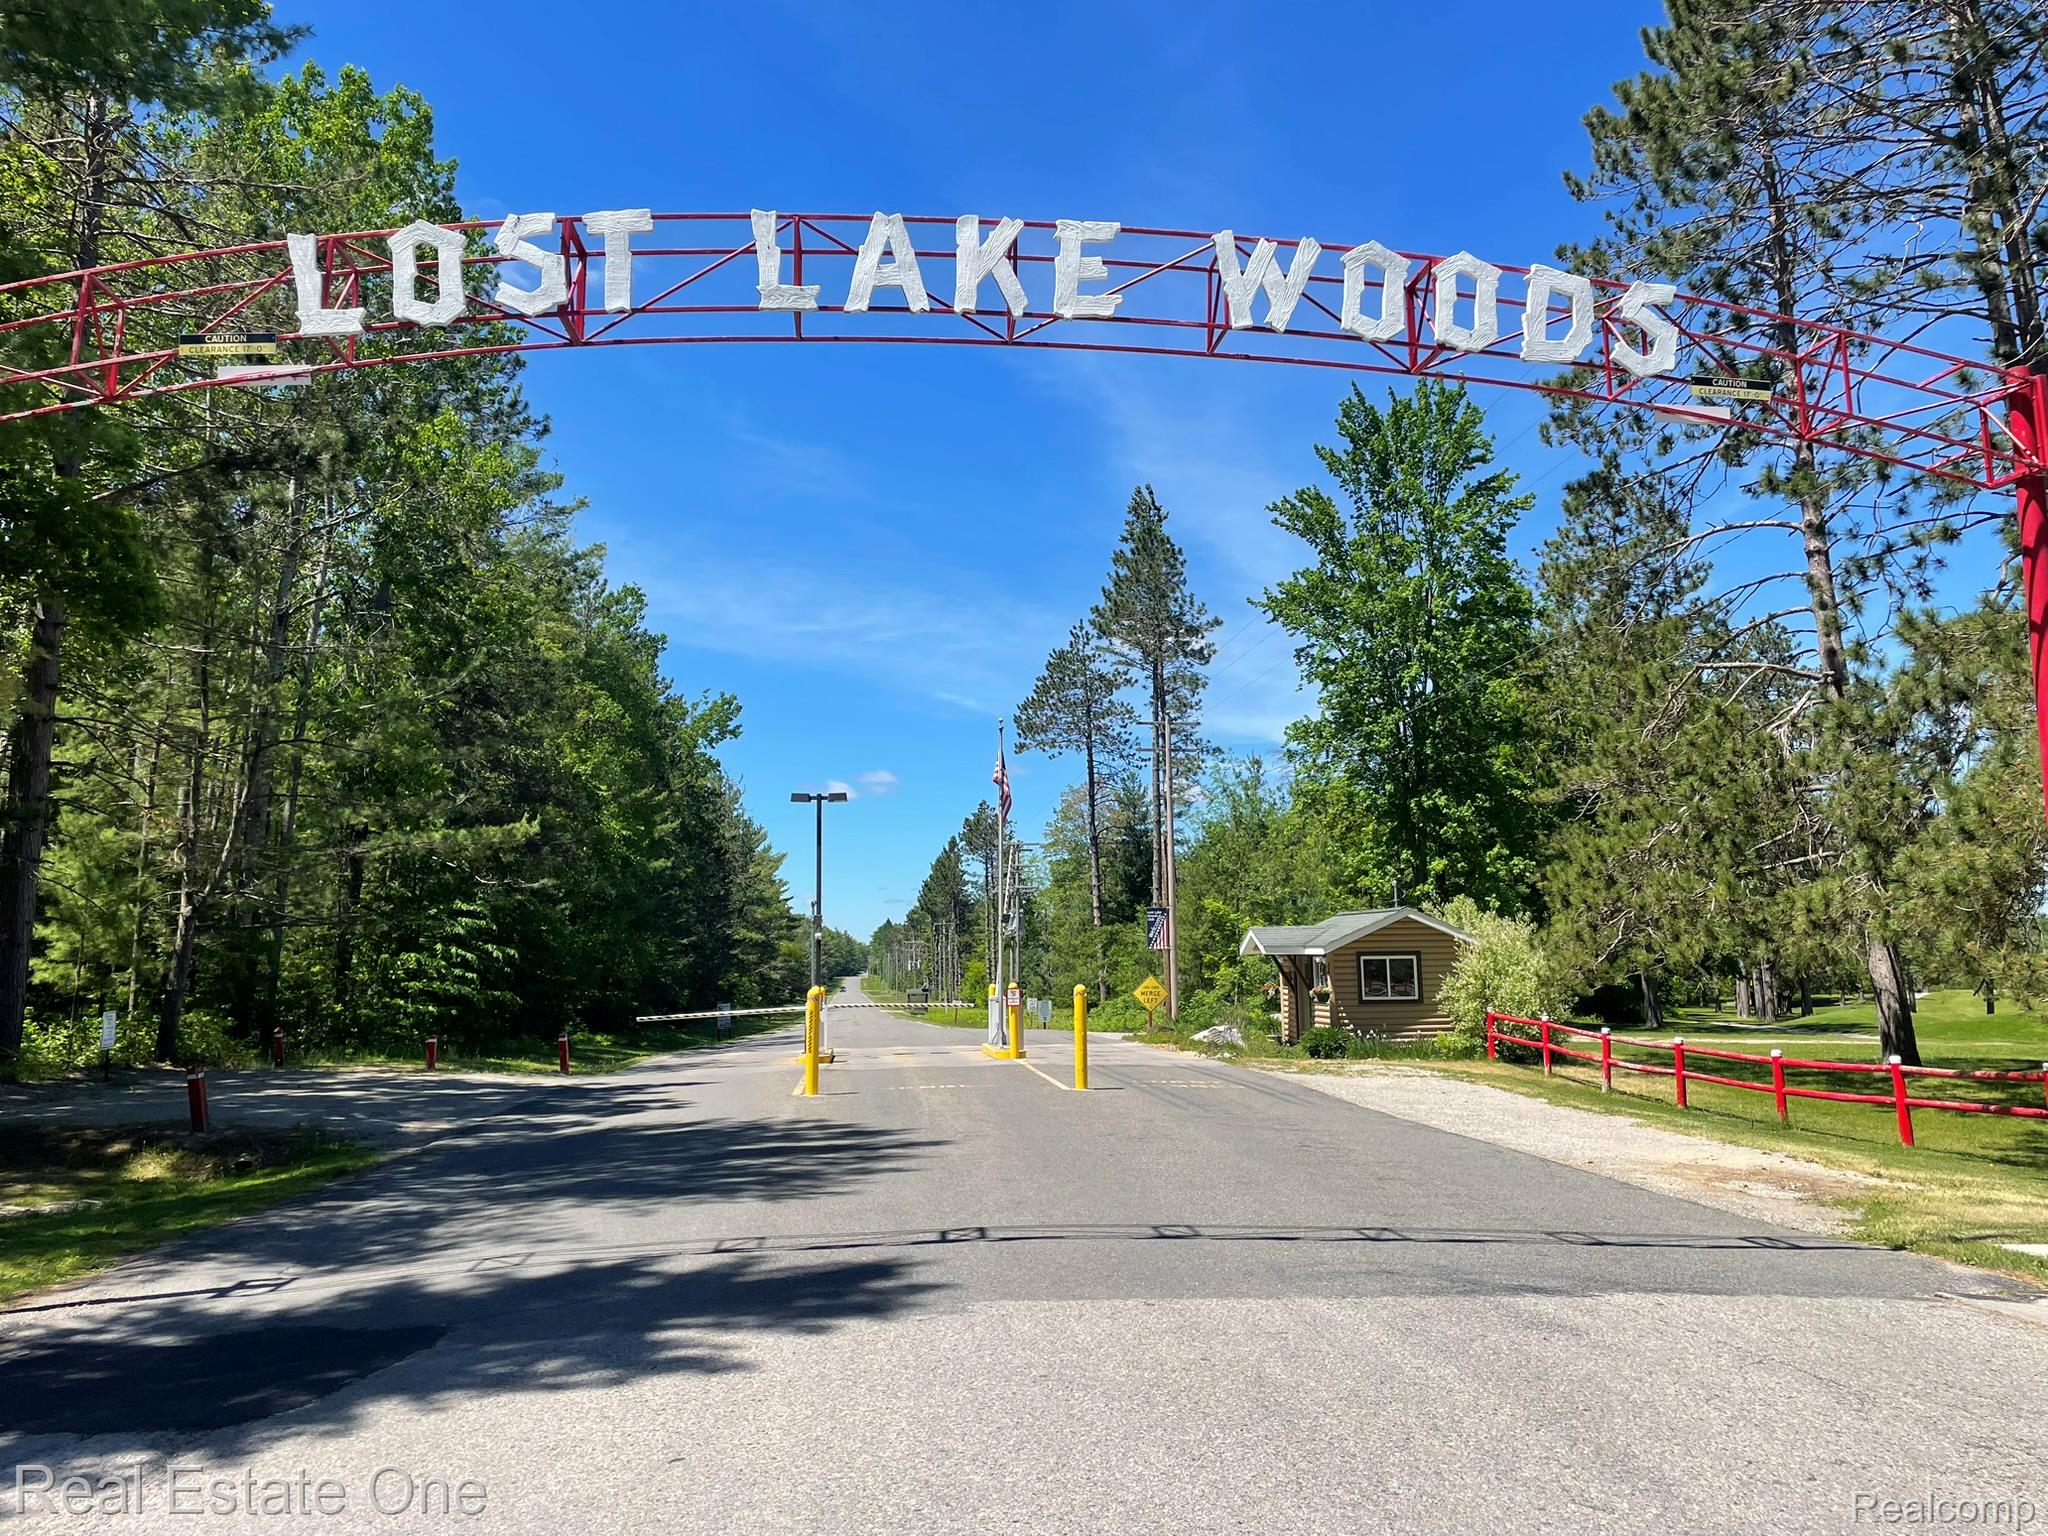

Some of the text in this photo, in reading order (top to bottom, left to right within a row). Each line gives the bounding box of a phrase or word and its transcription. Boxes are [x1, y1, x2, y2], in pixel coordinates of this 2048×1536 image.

[287, 208, 1680, 377] LOST LAKE WOODS
[205, 335, 247, 343] CAUTION
[188, 345, 239, 354] CLEARANCE
[1712, 378, 1747, 388] CAUTION
[1699, 388, 1741, 397] CLEARANCE
